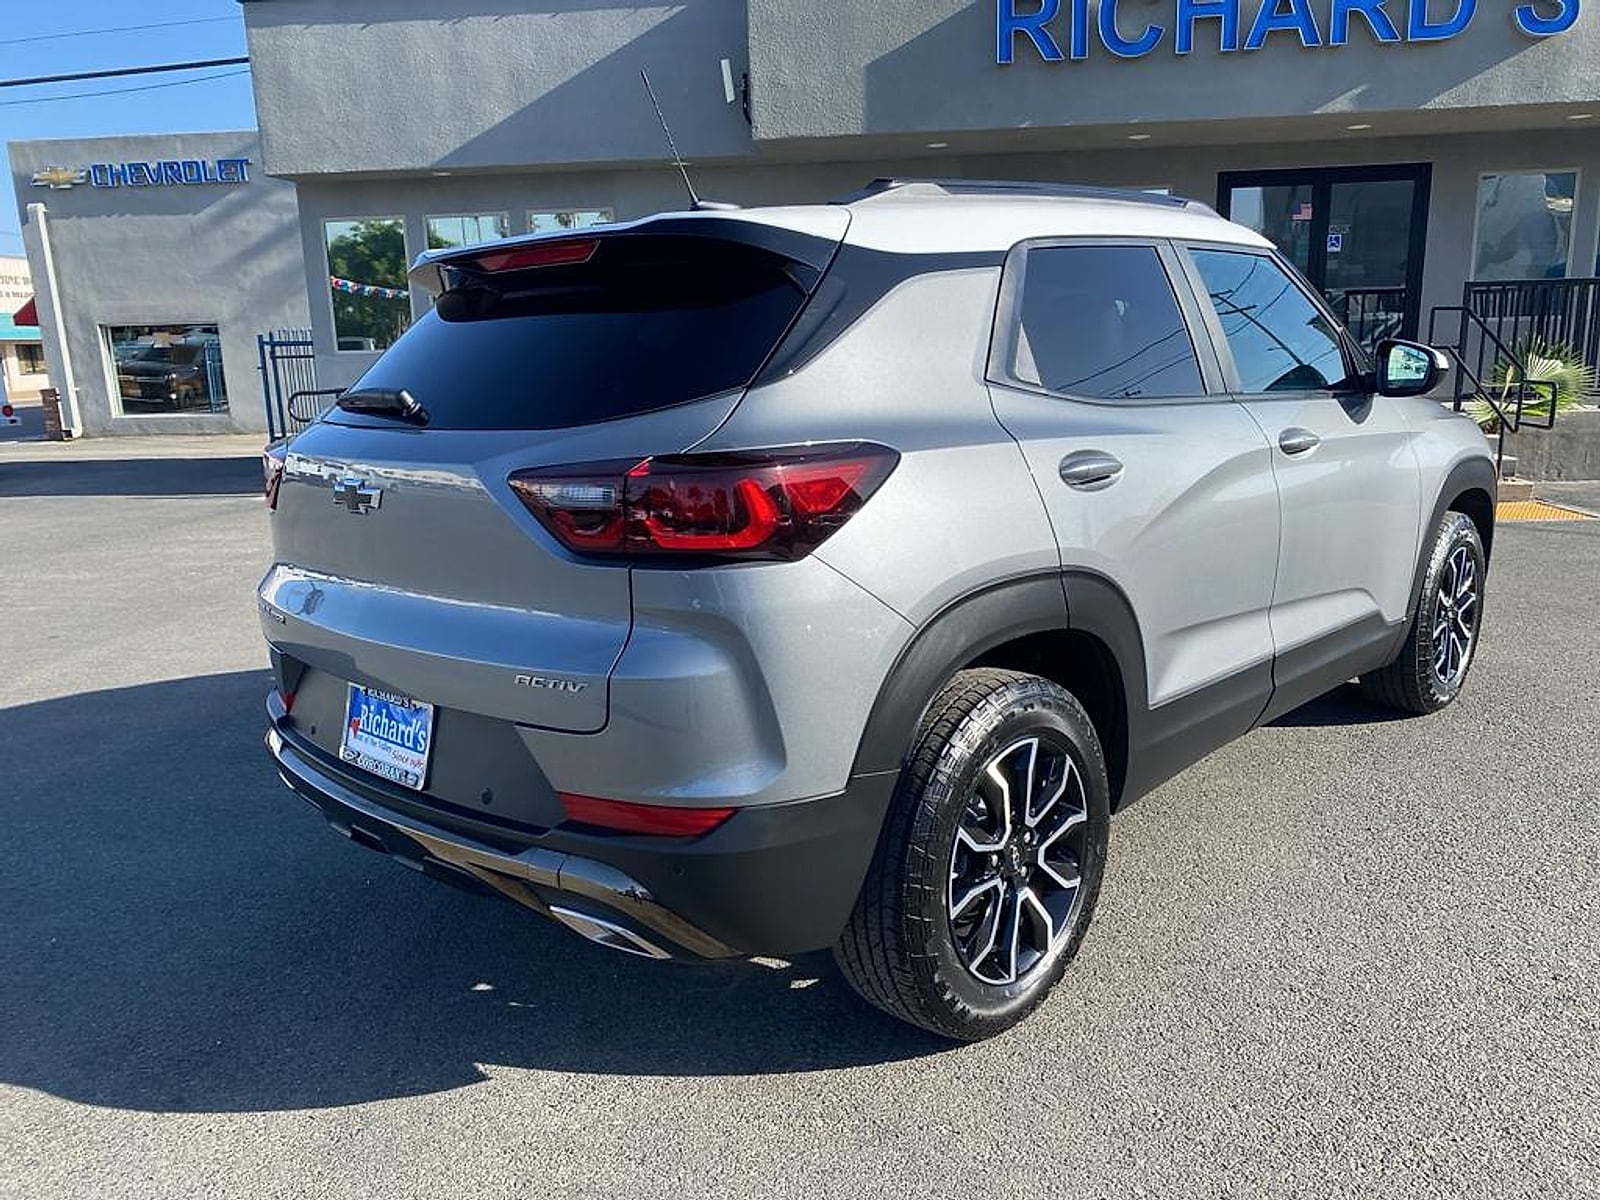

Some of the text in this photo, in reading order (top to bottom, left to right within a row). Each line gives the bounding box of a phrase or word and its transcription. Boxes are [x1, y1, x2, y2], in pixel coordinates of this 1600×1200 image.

[91, 159, 249, 187] CHEVROLET
[514, 674, 588, 692] ACTIV
[360, 704, 426, 751] Richard's
